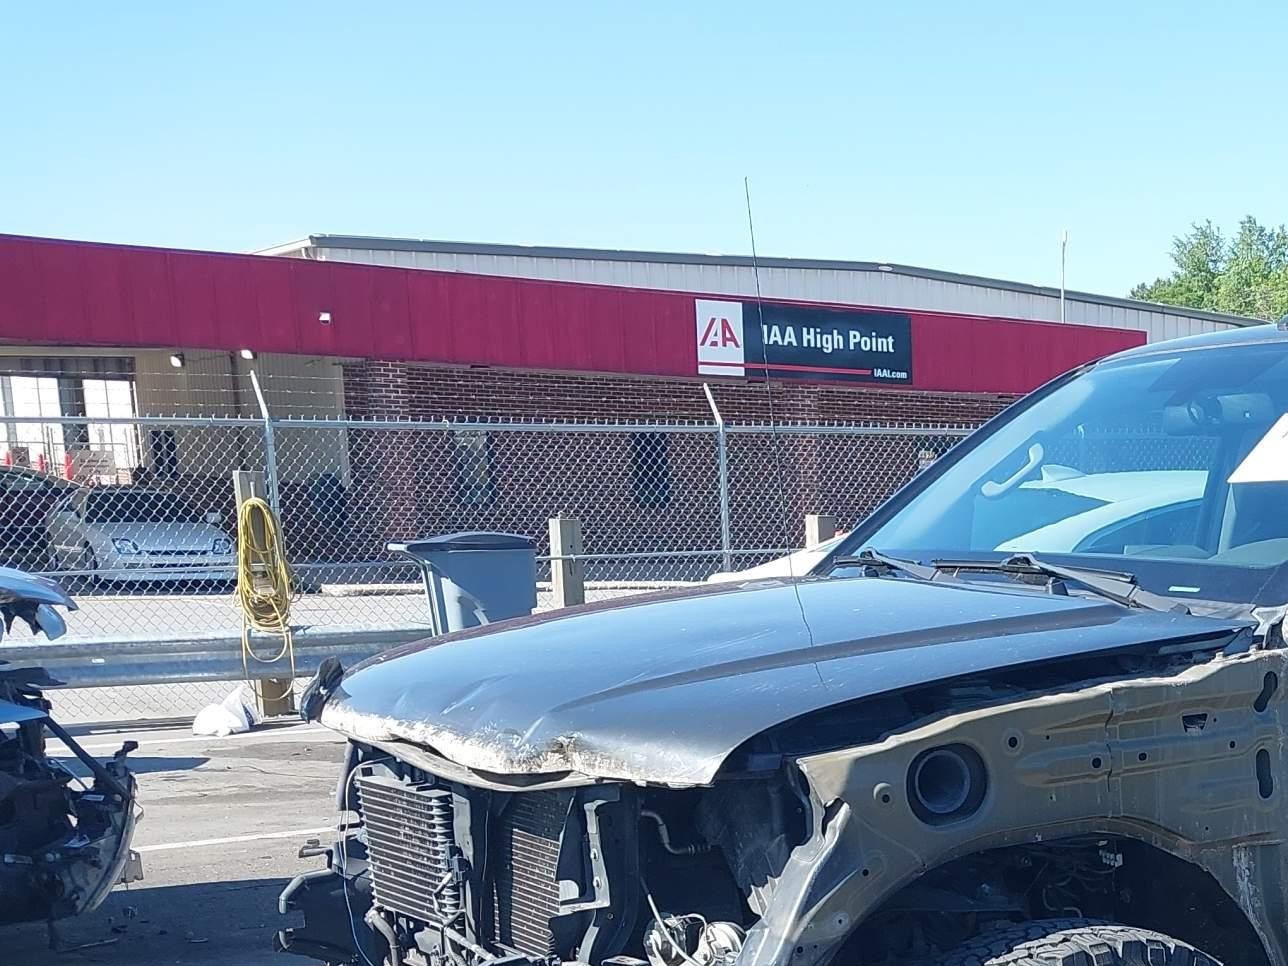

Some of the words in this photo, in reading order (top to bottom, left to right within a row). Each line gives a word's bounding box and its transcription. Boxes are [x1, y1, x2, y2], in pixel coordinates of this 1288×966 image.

[763, 324, 798, 347] IAA
[802, 327, 844, 354] High
[849, 330, 895, 353] Point
